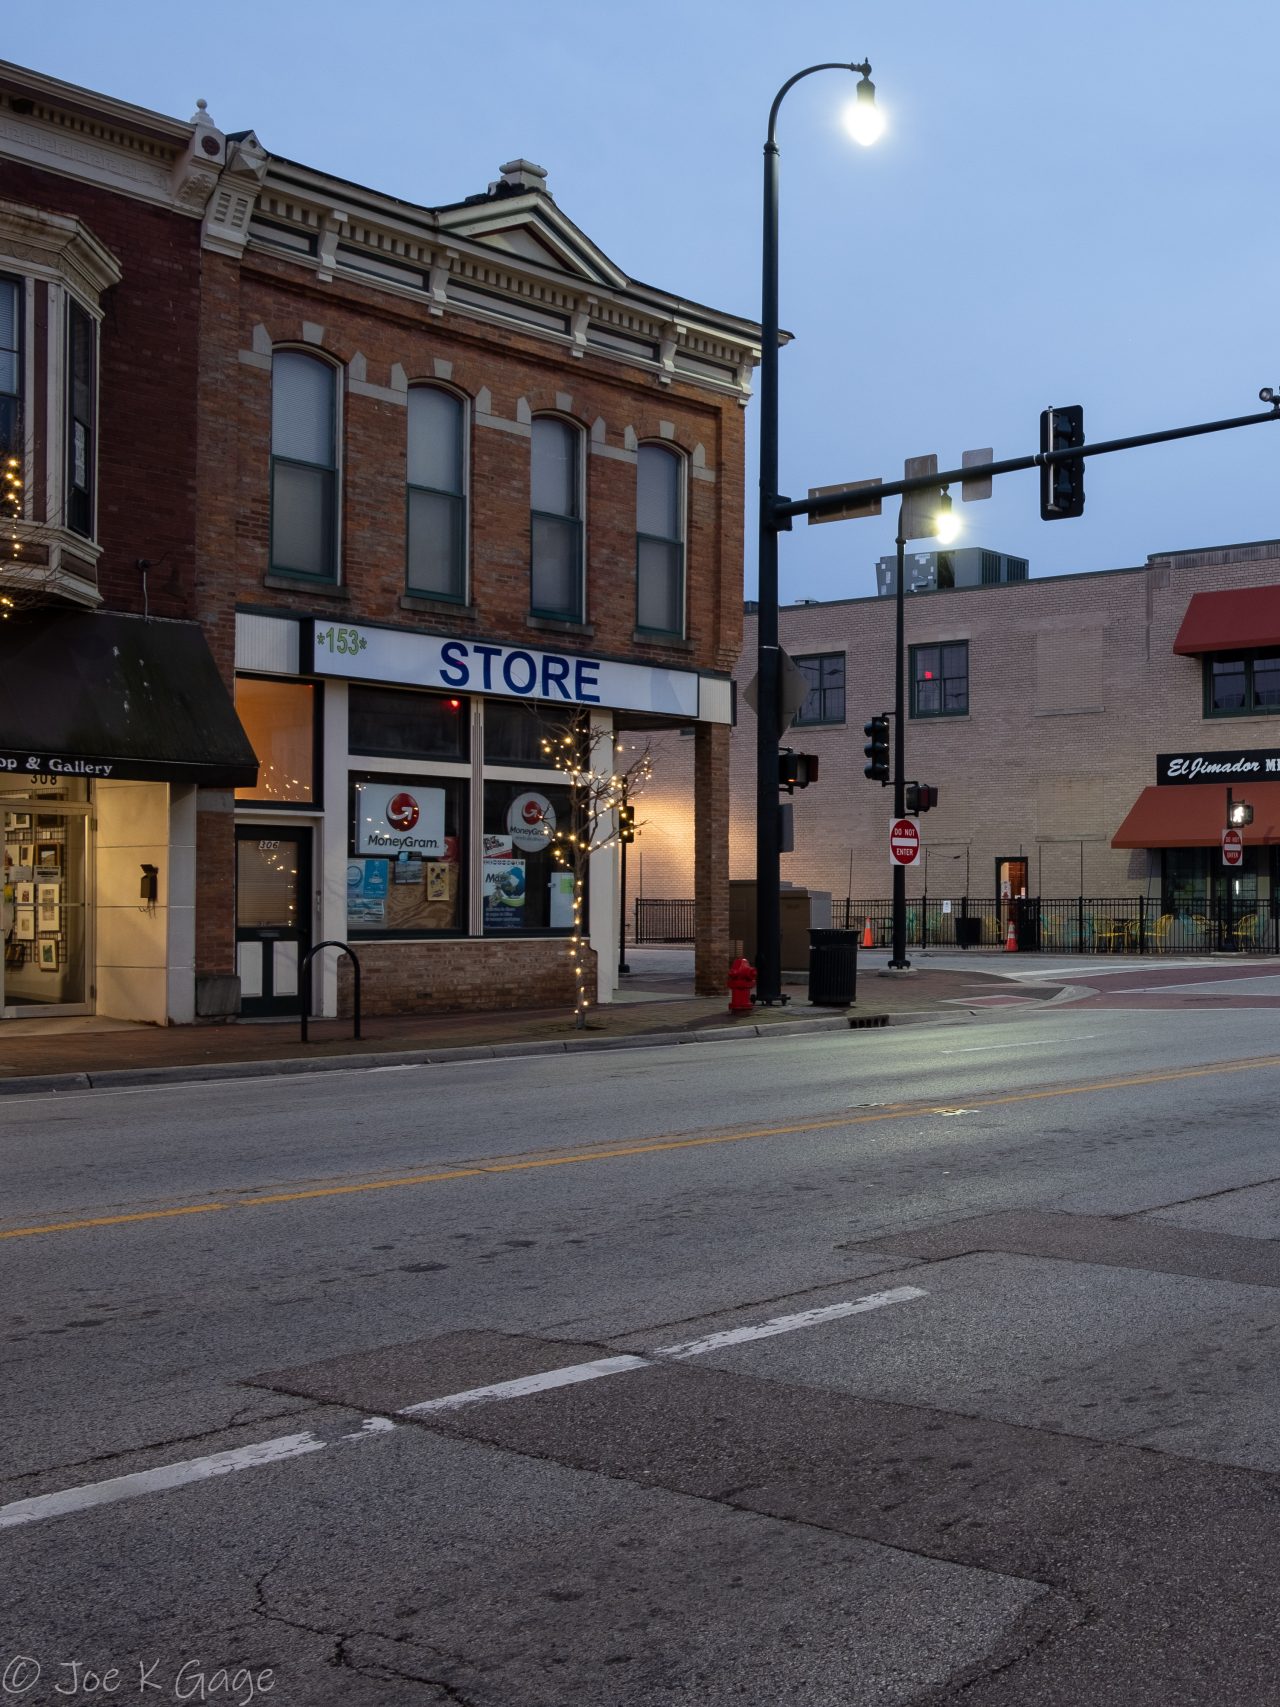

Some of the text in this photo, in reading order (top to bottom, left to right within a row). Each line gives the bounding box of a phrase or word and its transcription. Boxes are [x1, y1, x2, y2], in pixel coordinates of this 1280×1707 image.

[440, 641, 600, 703] STORE
[25, 756, 41, 770] &
[48, 758, 113, 776] Gallery
[1167, 758, 1189, 777] El
[1189, 757, 1260, 779] Jimador
[510, 826, 546, 837] MoneyGra
[260, 841, 278, 849] 306
[368, 834, 437, 850] MoneyGram
[896, 848, 913, 856] ENTER
